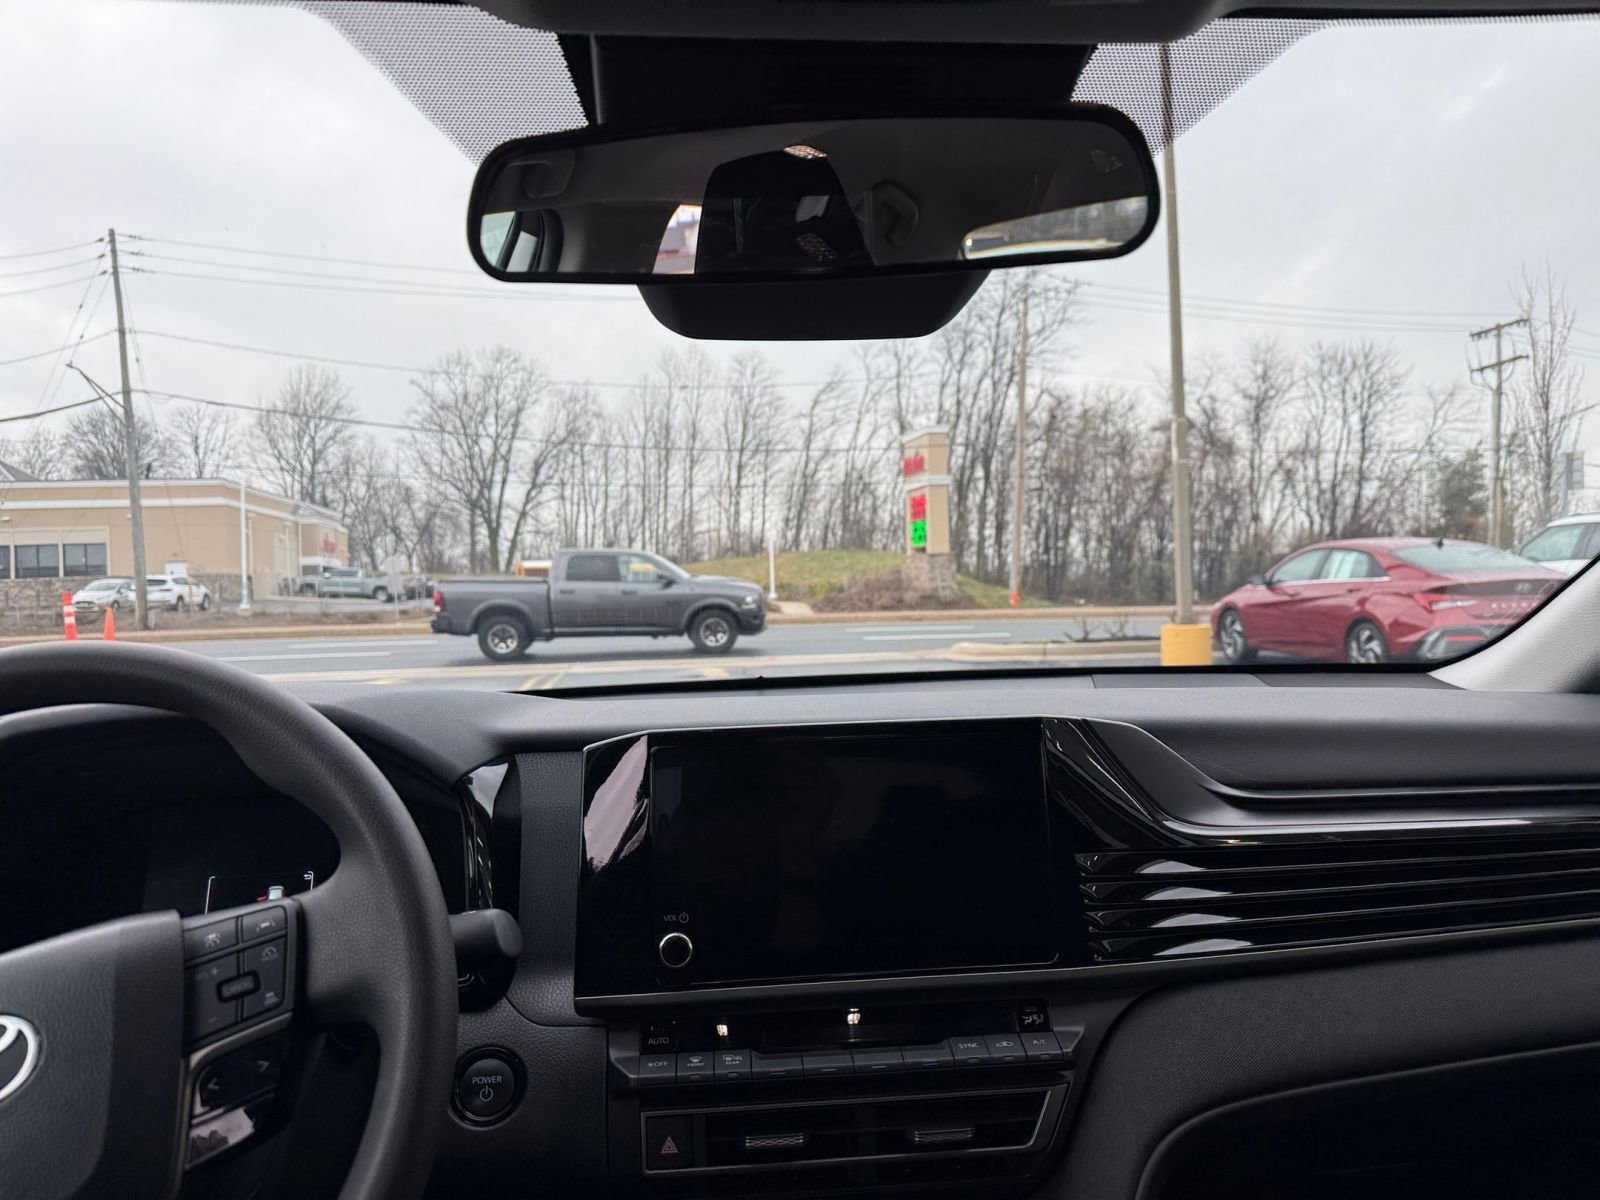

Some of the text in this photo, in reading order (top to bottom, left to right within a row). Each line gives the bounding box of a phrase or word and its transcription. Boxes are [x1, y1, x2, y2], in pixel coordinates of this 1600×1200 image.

[663, 914, 677, 922] VOL
[648, 1037, 669, 1045] AUTO
[472, 1075, 502, 1085] POWER
